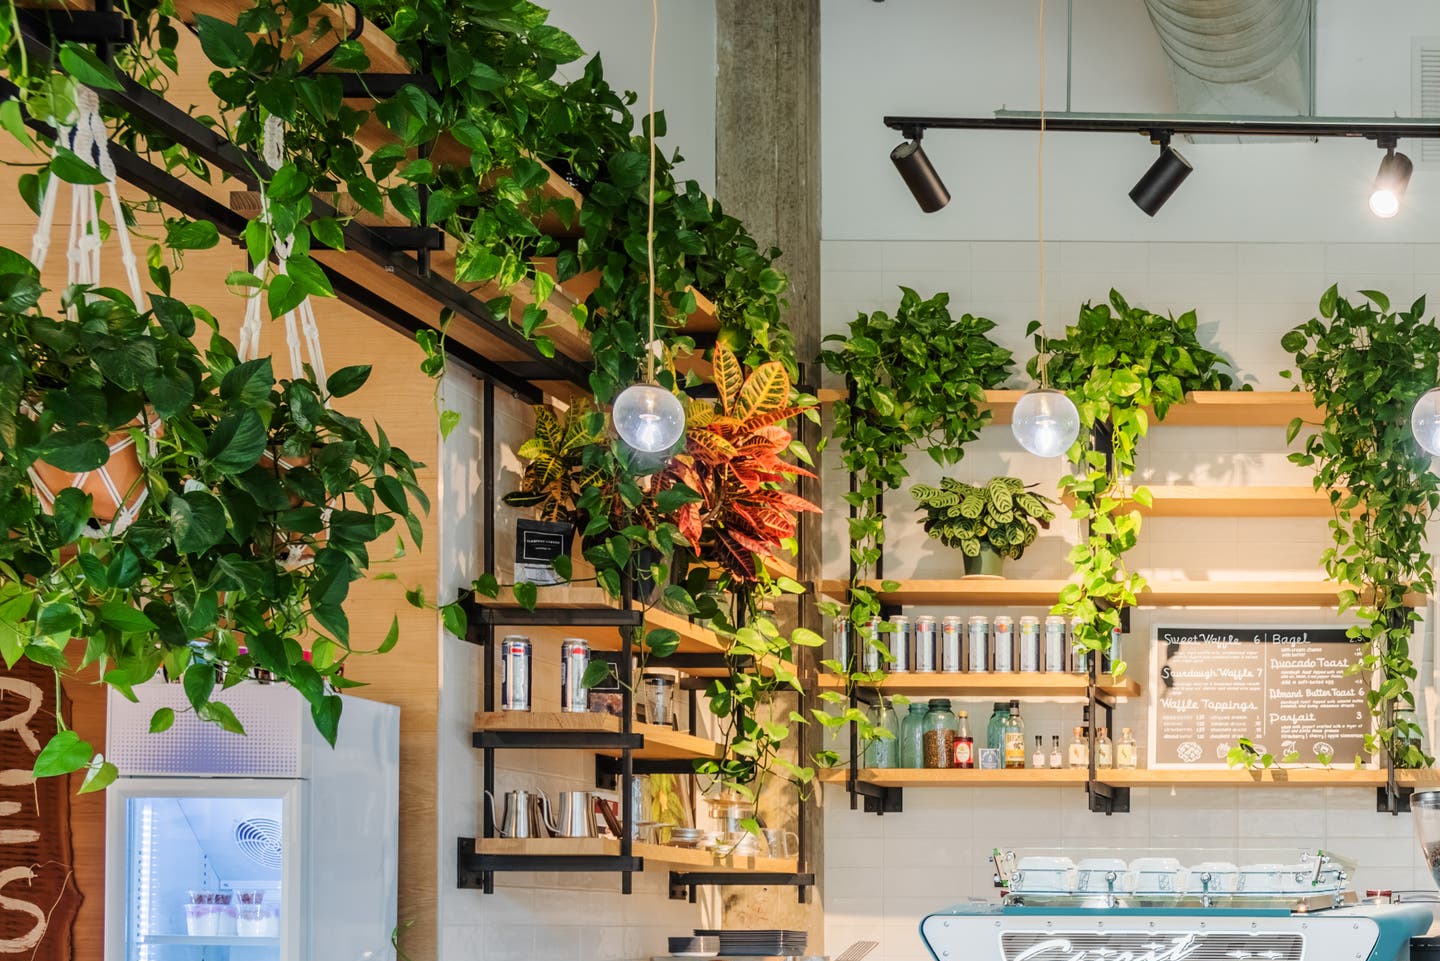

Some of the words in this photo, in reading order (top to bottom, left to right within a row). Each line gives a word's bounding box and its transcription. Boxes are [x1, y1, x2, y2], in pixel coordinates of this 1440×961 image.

[1163, 633, 1200, 646] Sweet
[1199, 633, 1242, 649] Waffle
[1253, 634, 1261, 645] 6
[1272, 632, 1311, 648] Bagel
[1270, 657, 1316, 669] Avocado
[1316, 657, 1350, 668] Toast
[1161, 667, 1217, 679] Sourdough
[1217, 667, 1255, 681] Waffle
[1256, 667, 1263, 678] 7
[1269, 688, 1304, 699] Almond
[1305, 688, 1331, 697] Butter
[1331, 688, 1357, 697] Toast
[1358, 687, 1366, 697] 6
[1160, 698, 1200, 712] Waffle
[1201, 698, 1259, 712] Toppings
[1269, 712, 1317, 725] Parfait
[1355, 711, 1363, 720] 3
